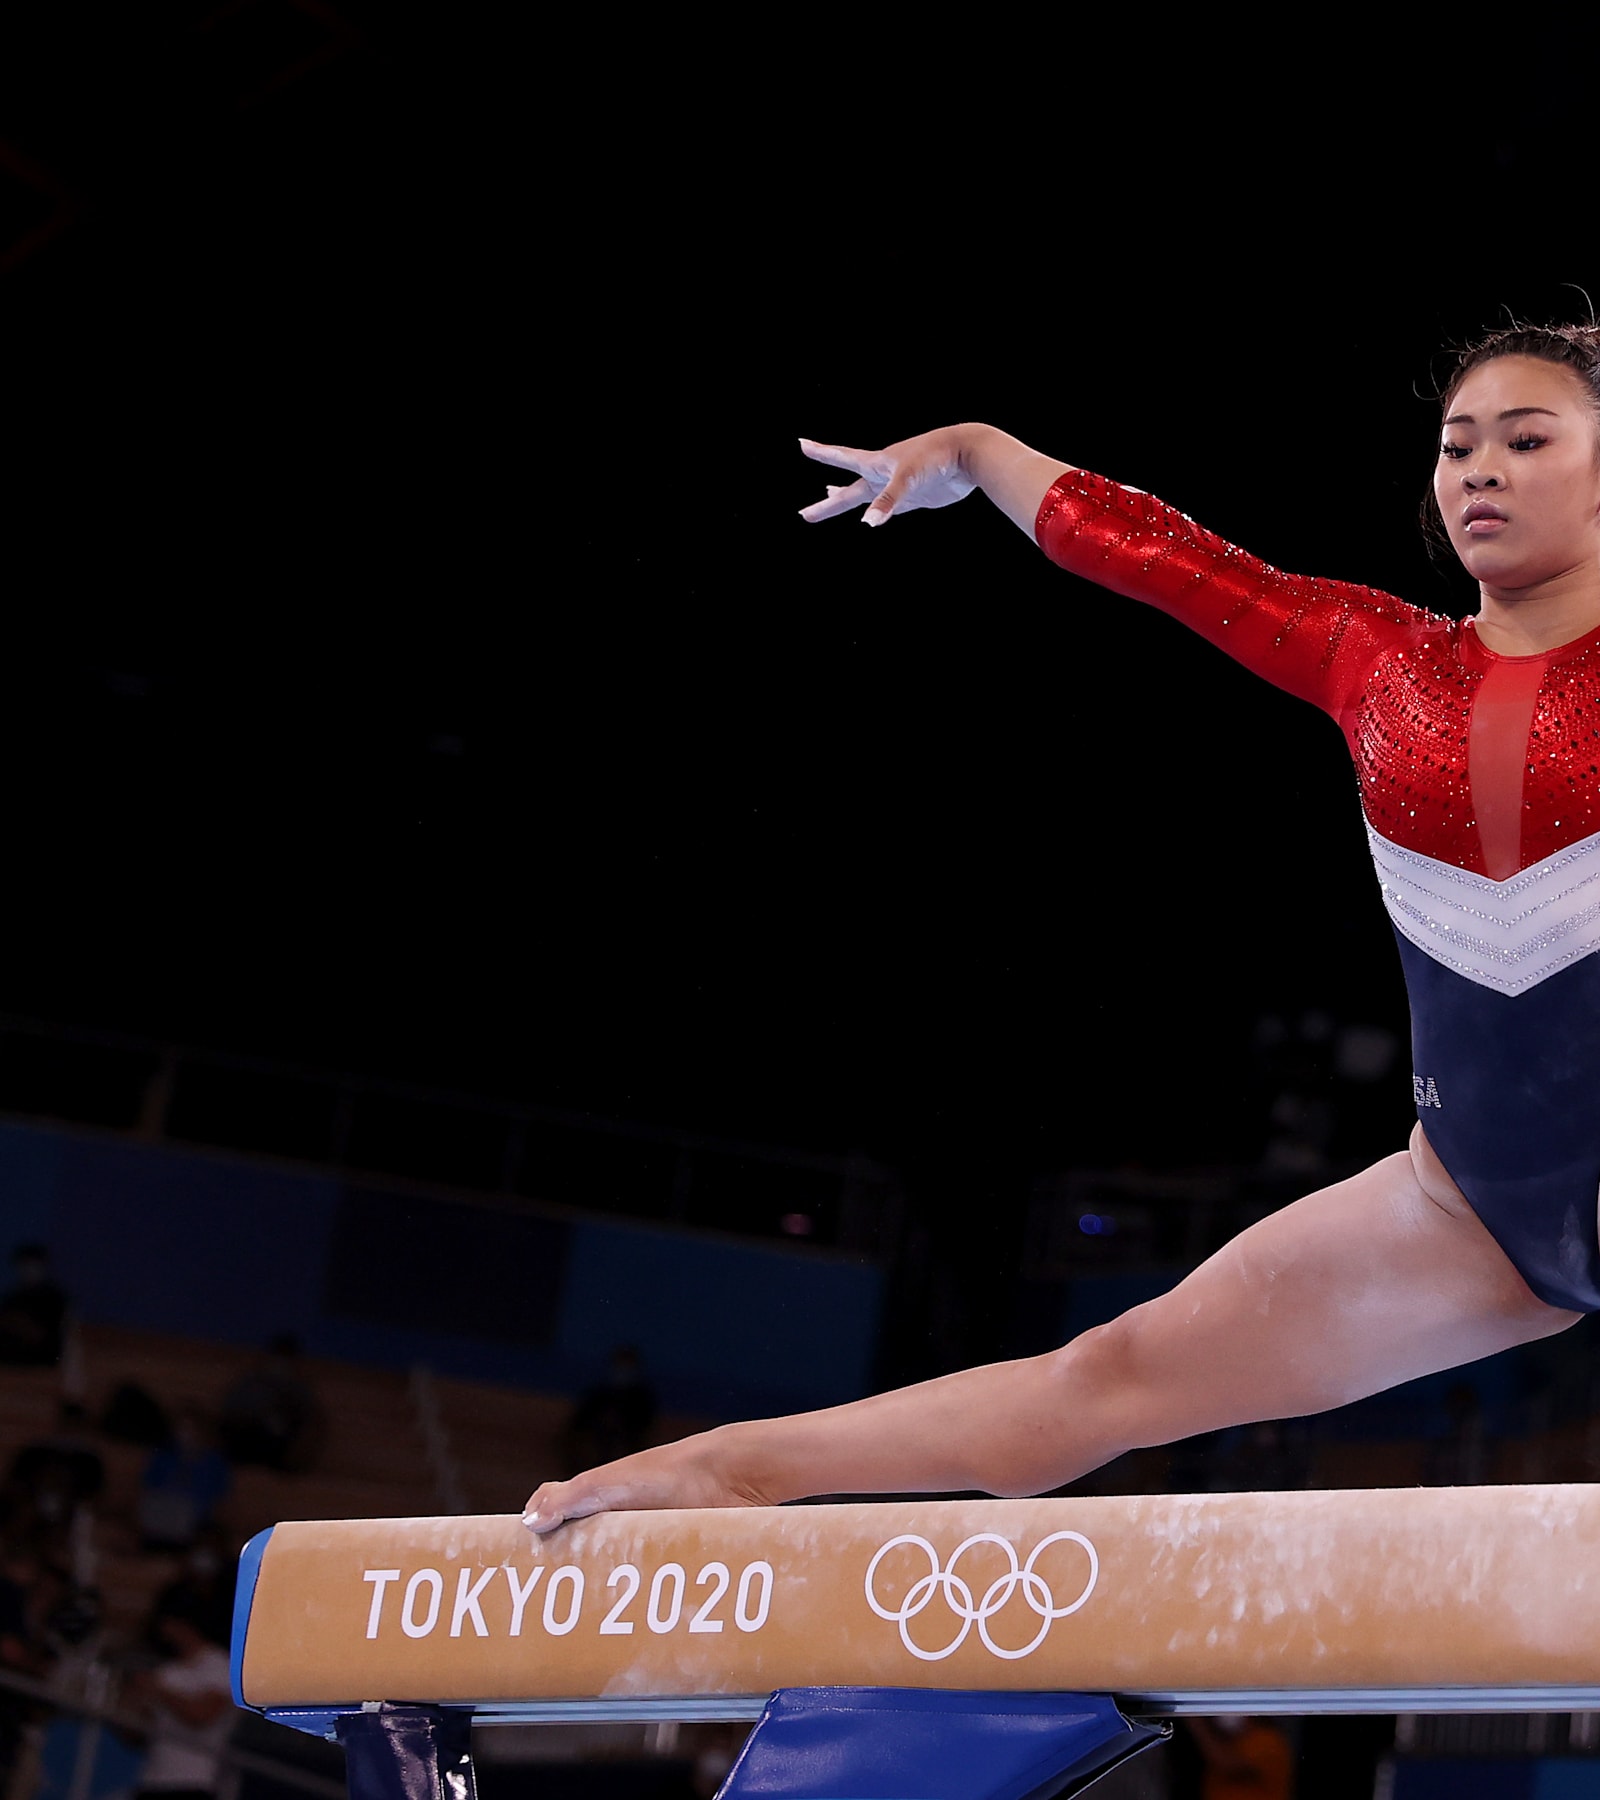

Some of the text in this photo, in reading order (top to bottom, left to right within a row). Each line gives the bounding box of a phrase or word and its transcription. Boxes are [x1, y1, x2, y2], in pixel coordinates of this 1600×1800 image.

[1413, 1075, 1442, 1109] SA
[363, 1561, 774, 1639] TOKYO 2020
